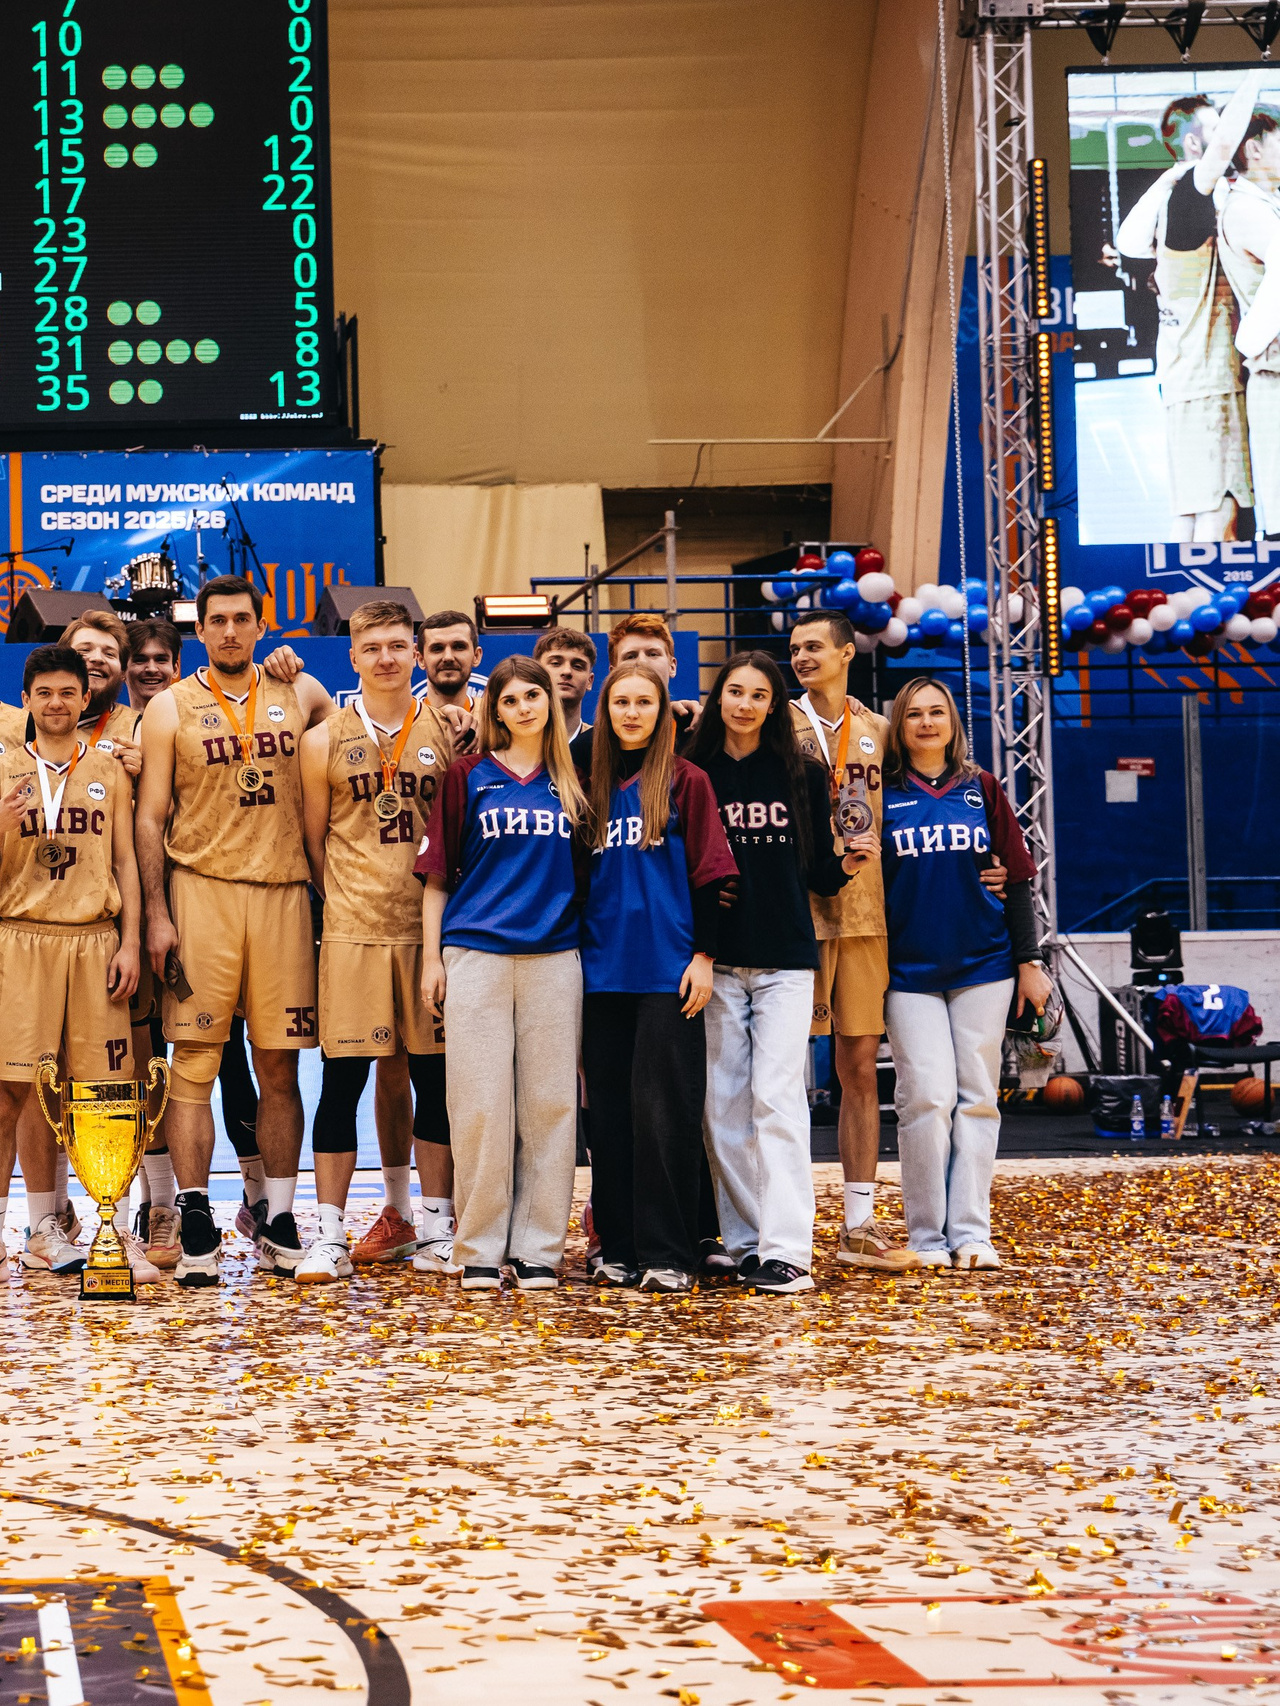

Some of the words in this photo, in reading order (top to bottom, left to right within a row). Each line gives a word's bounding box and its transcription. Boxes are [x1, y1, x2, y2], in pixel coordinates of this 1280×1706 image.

[32, 21, 81, 57] 10
[289, 17, 311, 52] 0
[32, 60, 76, 96] 11
[289, 56, 312, 92] 2
[33, 99, 83, 135] 13
[290, 95, 313, 131] 0
[34, 138, 84, 174] 15
[264, 135, 314, 170] 12
[35, 178, 86, 214] 17
[263, 174, 315, 210] 22
[34, 217, 86, 253] 23
[293, 213, 316, 249] 0
[34, 256, 87, 292] 27
[294, 253, 317, 288] 0
[35, 296, 87, 332] 28
[295, 292, 318, 327] 5
[36, 335, 81, 371] 31
[296, 331, 319, 367] 8
[37, 375, 89, 411] 35
[270, 371, 320, 407] 13
[40, 484, 121, 506] СРЕДИ
[125, 482, 251, 504] МУЖСКИХ
[252, 481, 356, 505] КОМАНД
[40, 510, 120, 531] СЕЗОН
[123, 509, 227, 531] 2025/26
[97, 742, 112, 750] РФБ
[419, 752, 435, 760] РФБ
[90, 787, 104, 795] РФБ
[378, 808, 414, 845] 28
[478, 806, 572, 840] ЦИВС
[722, 801, 789, 830] ИВС
[891, 824, 988, 858] ЦИВС
[50, 846, 77, 881] 7
[285, 1006, 315, 1037] 35
[104, 1038, 128, 1072] 17
